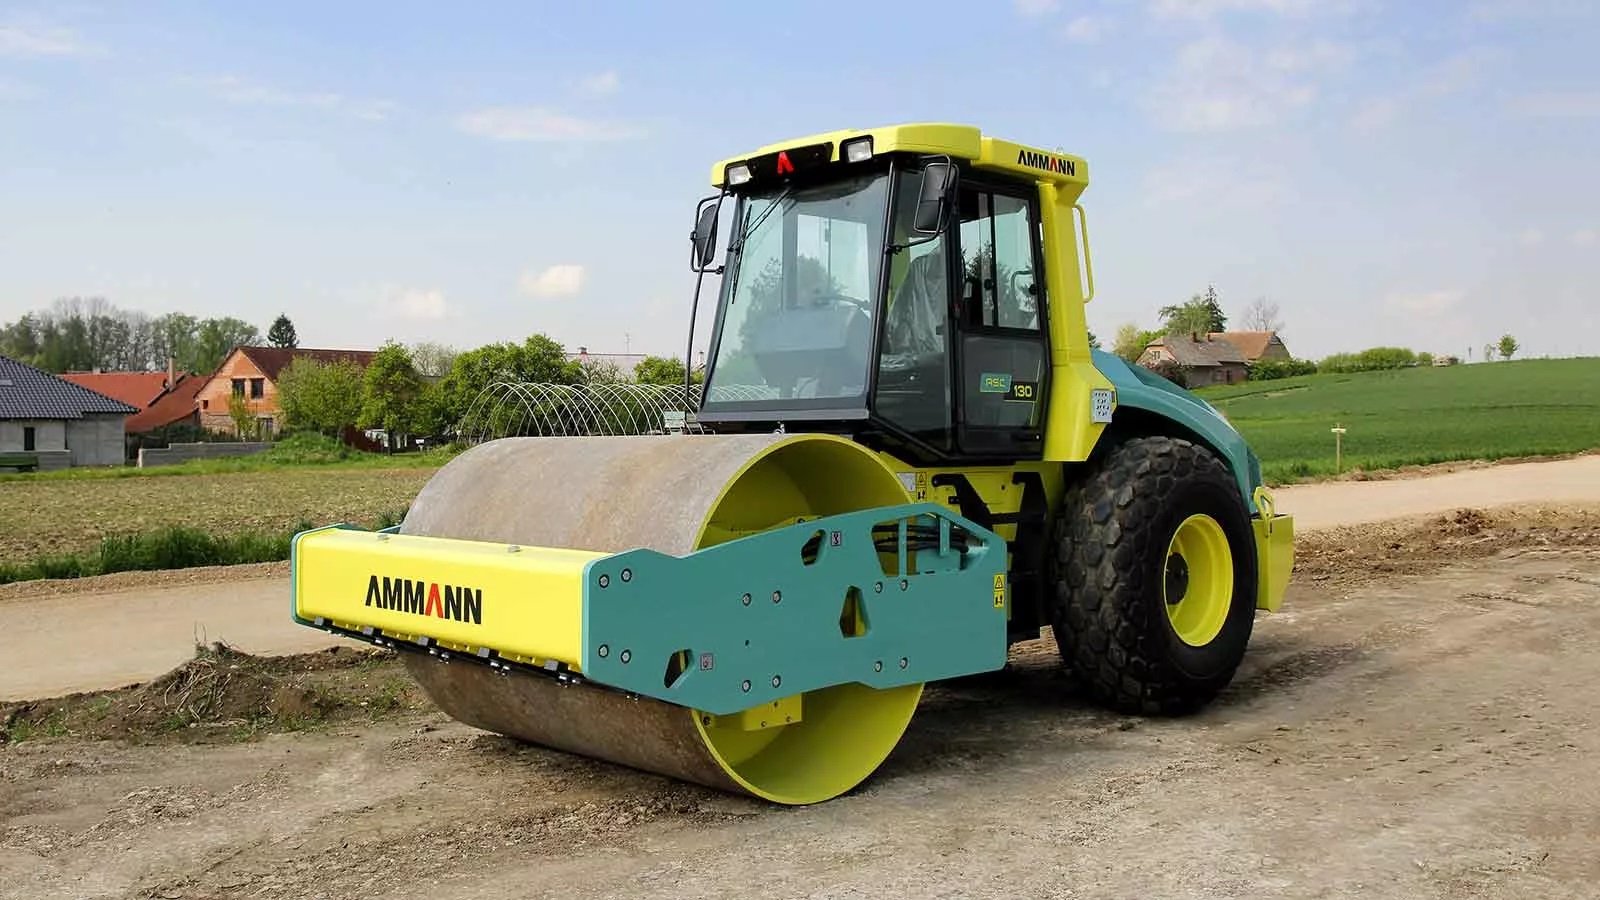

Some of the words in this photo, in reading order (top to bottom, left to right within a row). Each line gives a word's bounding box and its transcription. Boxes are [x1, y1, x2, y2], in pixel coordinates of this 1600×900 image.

[1018, 150, 1075, 176] AMMANN
[1014, 385, 1033, 398] 130
[365, 575, 482, 625] AMMANN
